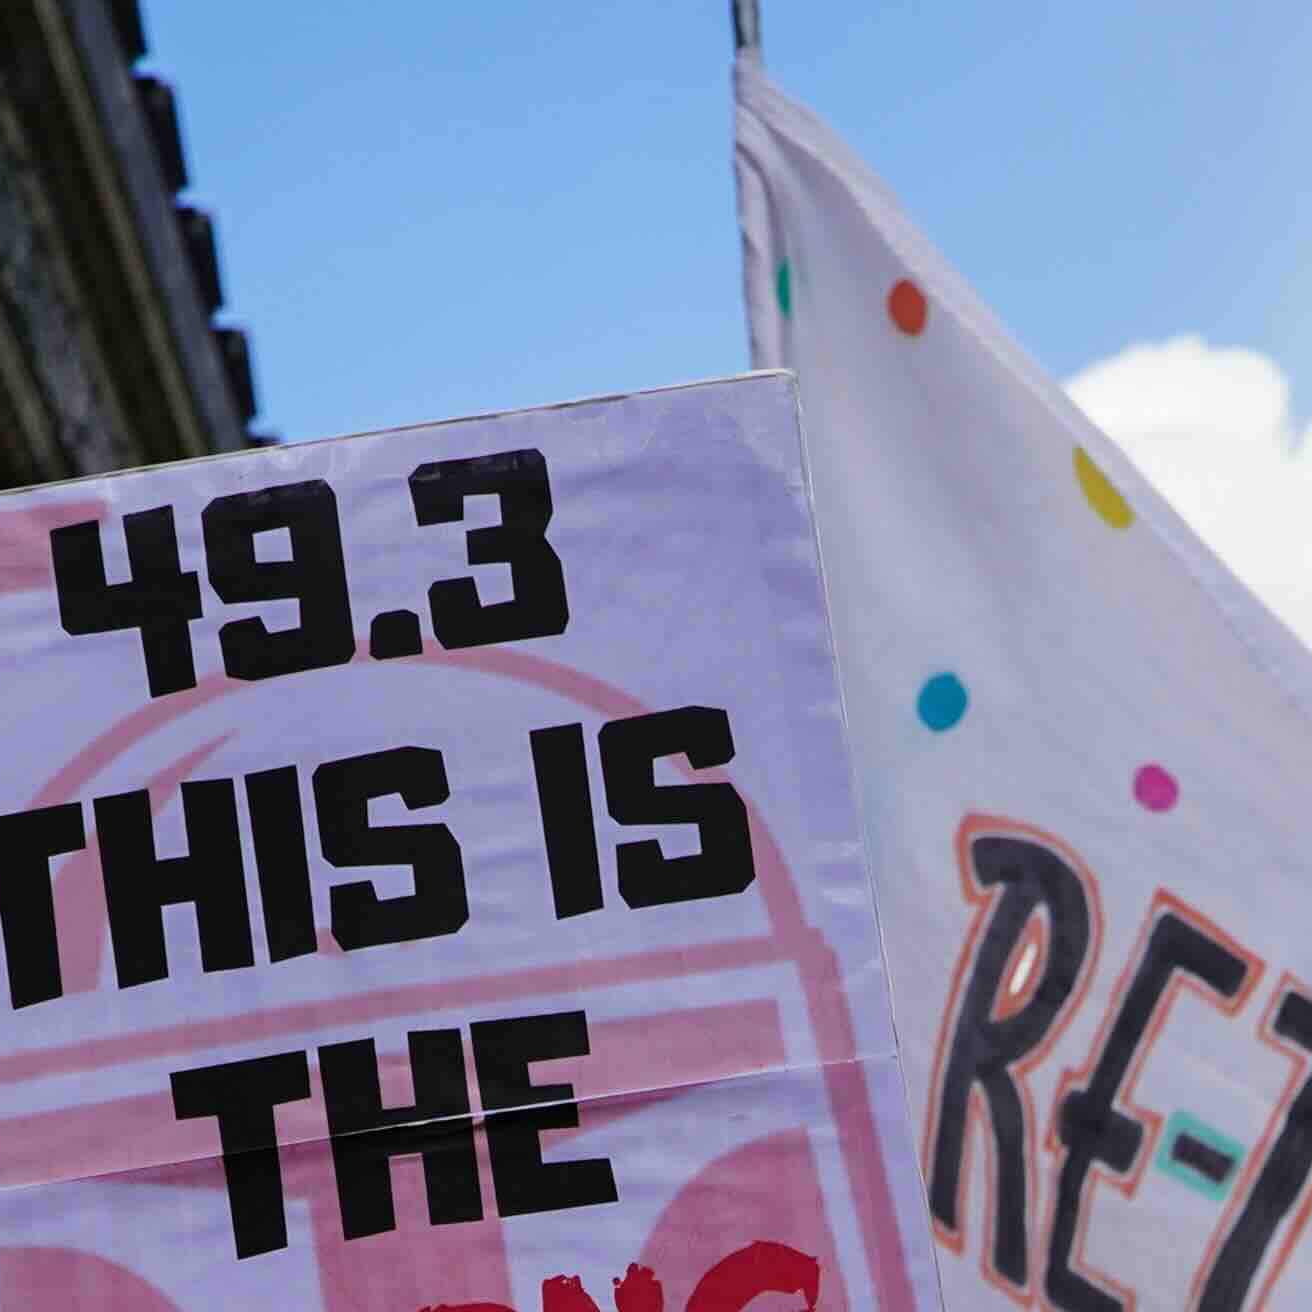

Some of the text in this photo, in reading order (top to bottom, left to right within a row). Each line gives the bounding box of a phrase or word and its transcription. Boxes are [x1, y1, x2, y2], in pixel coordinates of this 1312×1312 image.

[49, 448, 569, 698] 49.3
[529, 705, 756, 920] IS
[168, 1010, 619, 1261] THE
